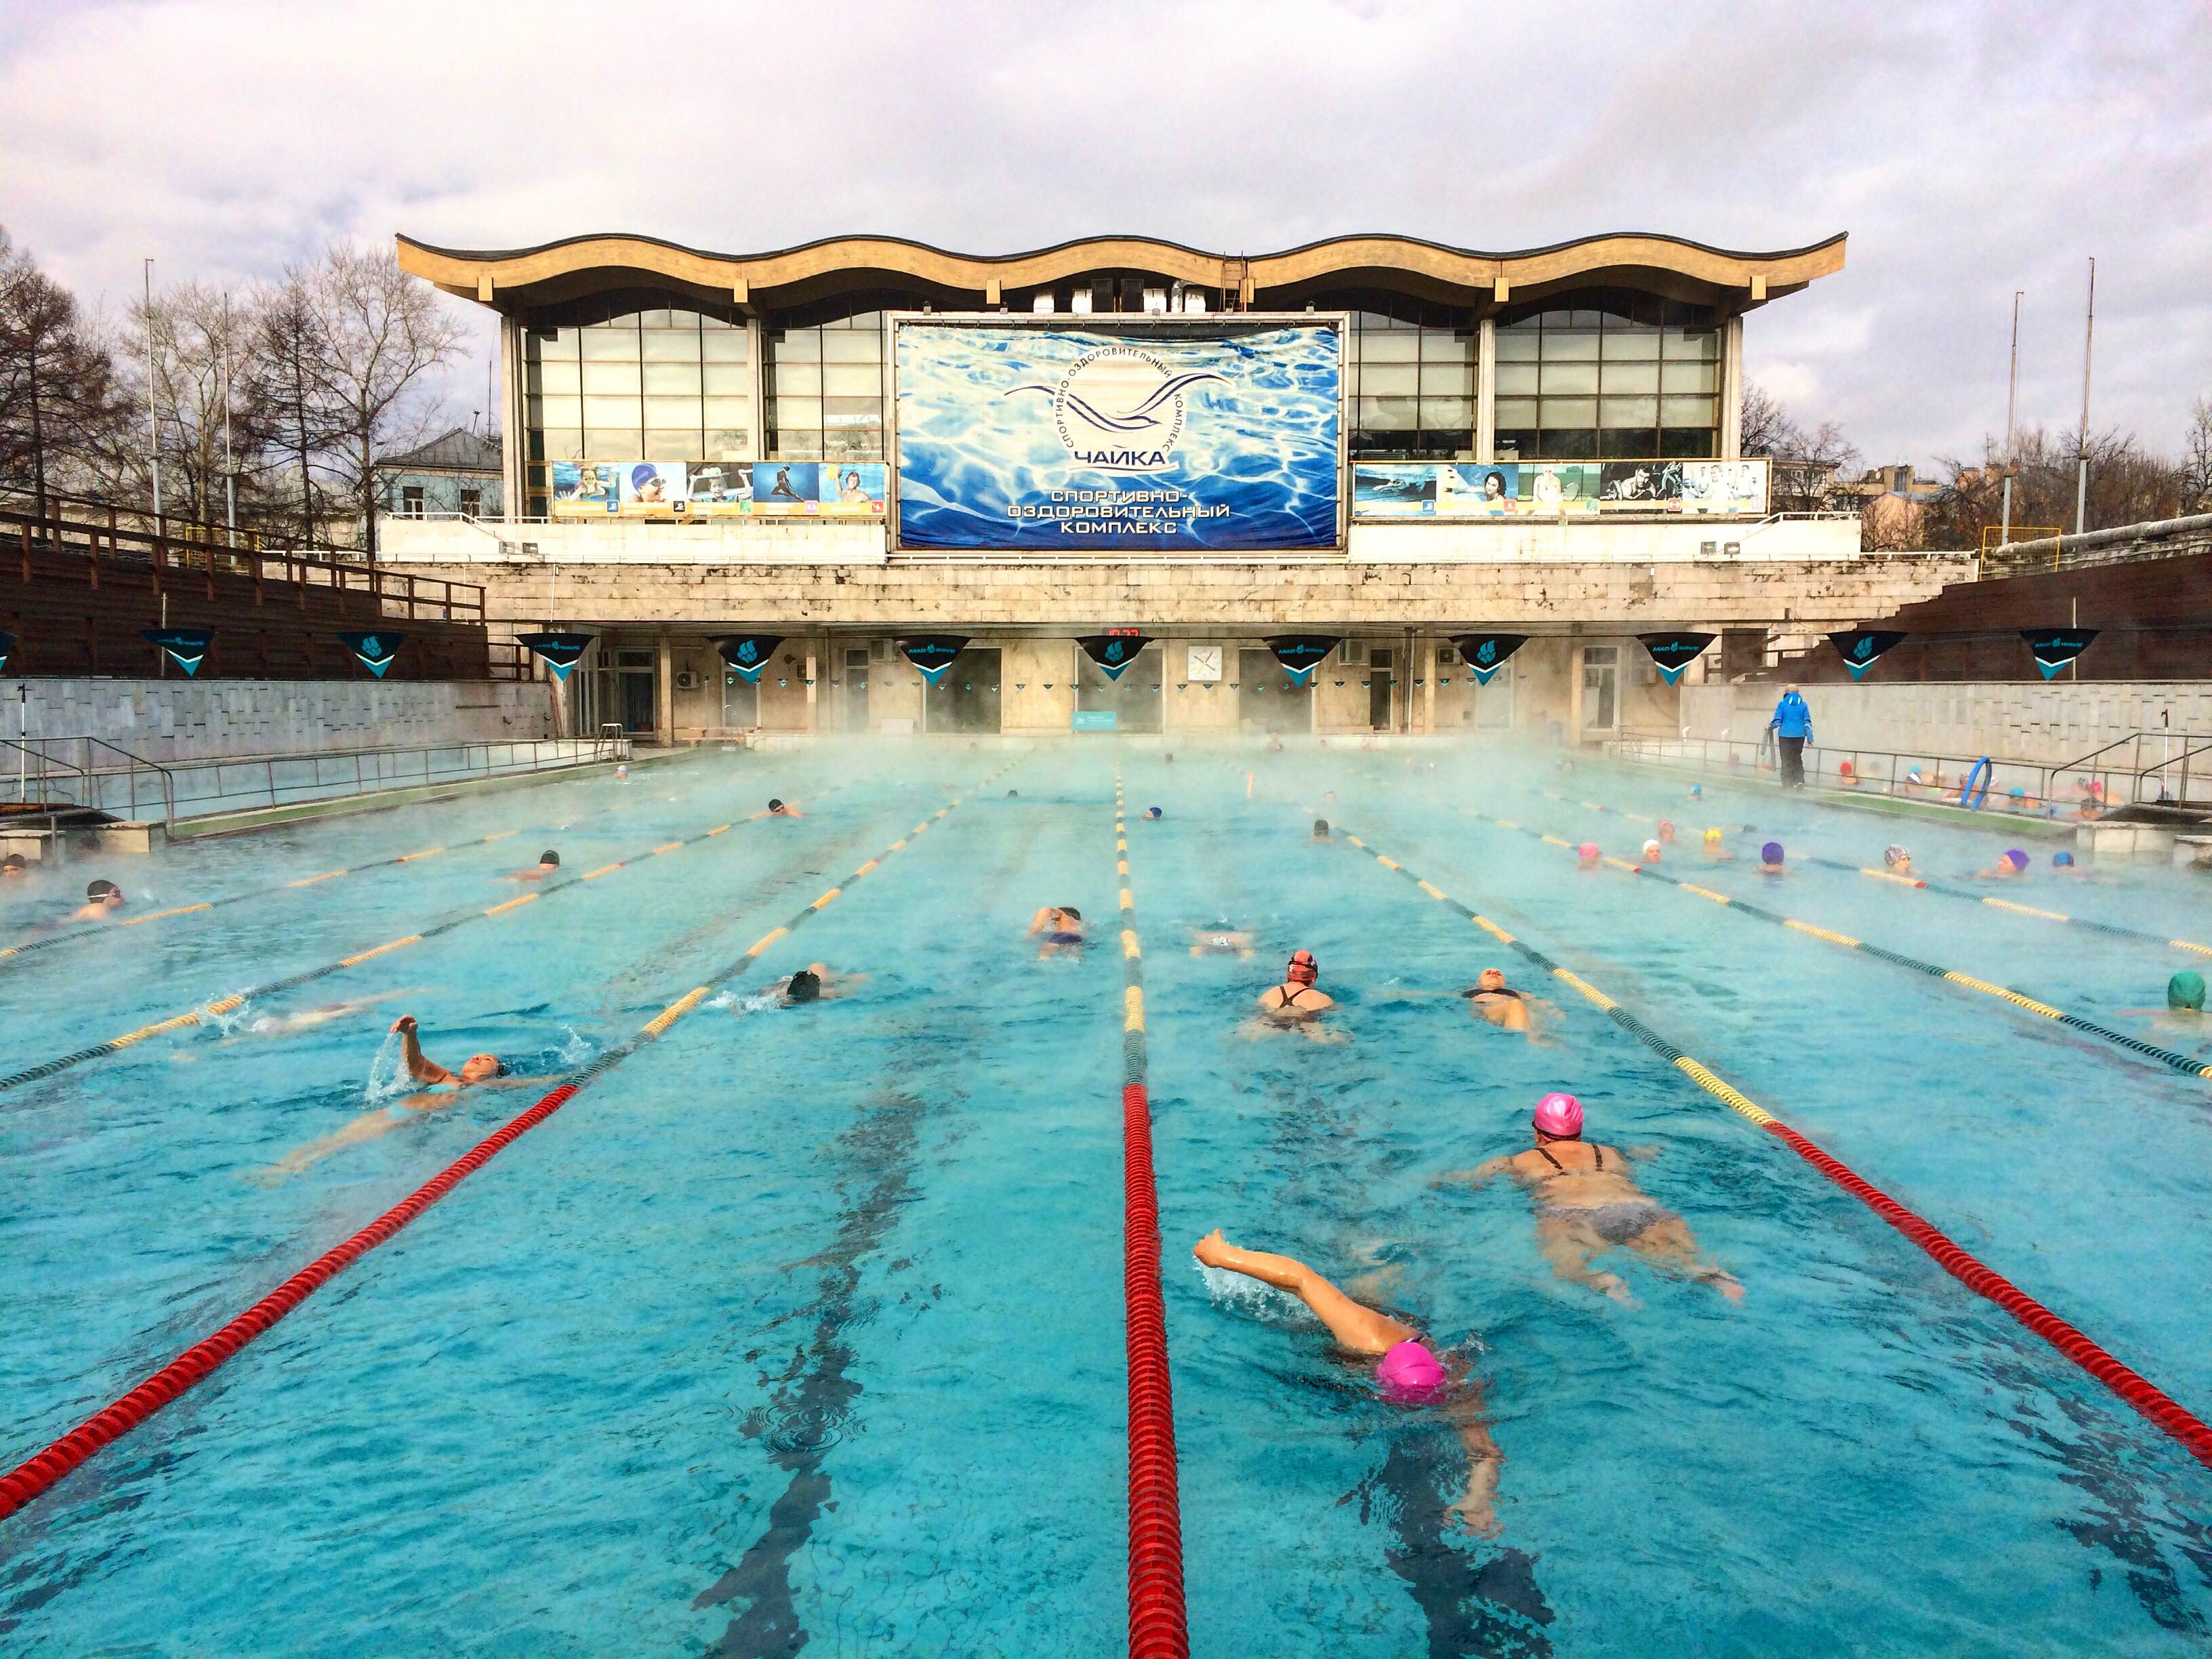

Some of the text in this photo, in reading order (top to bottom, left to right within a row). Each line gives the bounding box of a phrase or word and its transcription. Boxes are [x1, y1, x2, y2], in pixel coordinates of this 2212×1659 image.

[1162, 392, 1183, 452] КОМПЛЕКС
[1074, 445, 1166, 466] ЧАЙКА
[1050, 489, 1189, 503] СПОРТИВНО-
[1007, 504, 1231, 520] ОЗДОРОВИТЕЛЬНЫЙ
[1060, 521, 1178, 535] КОМПЛЕКС
